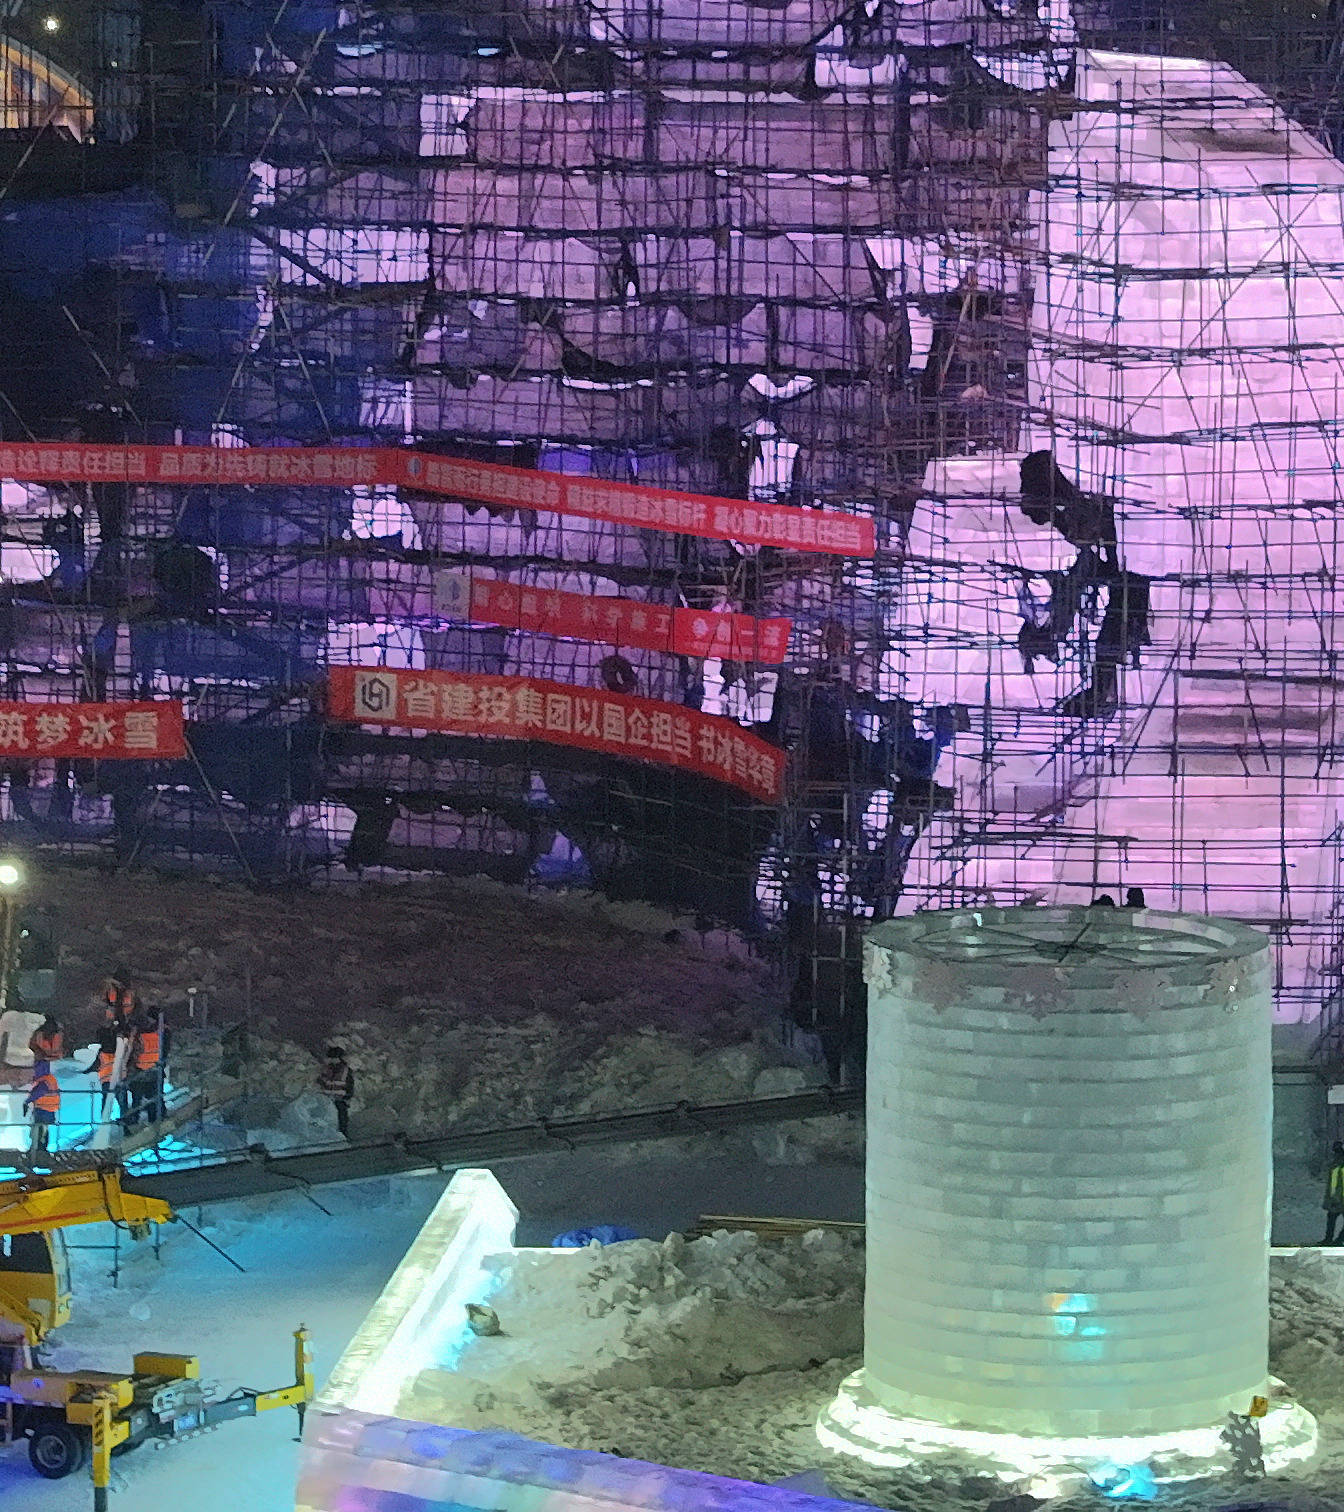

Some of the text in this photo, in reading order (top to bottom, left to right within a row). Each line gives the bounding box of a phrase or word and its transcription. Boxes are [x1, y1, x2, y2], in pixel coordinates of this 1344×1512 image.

[402, 678, 693, 758] 省建投集团以国企担当
